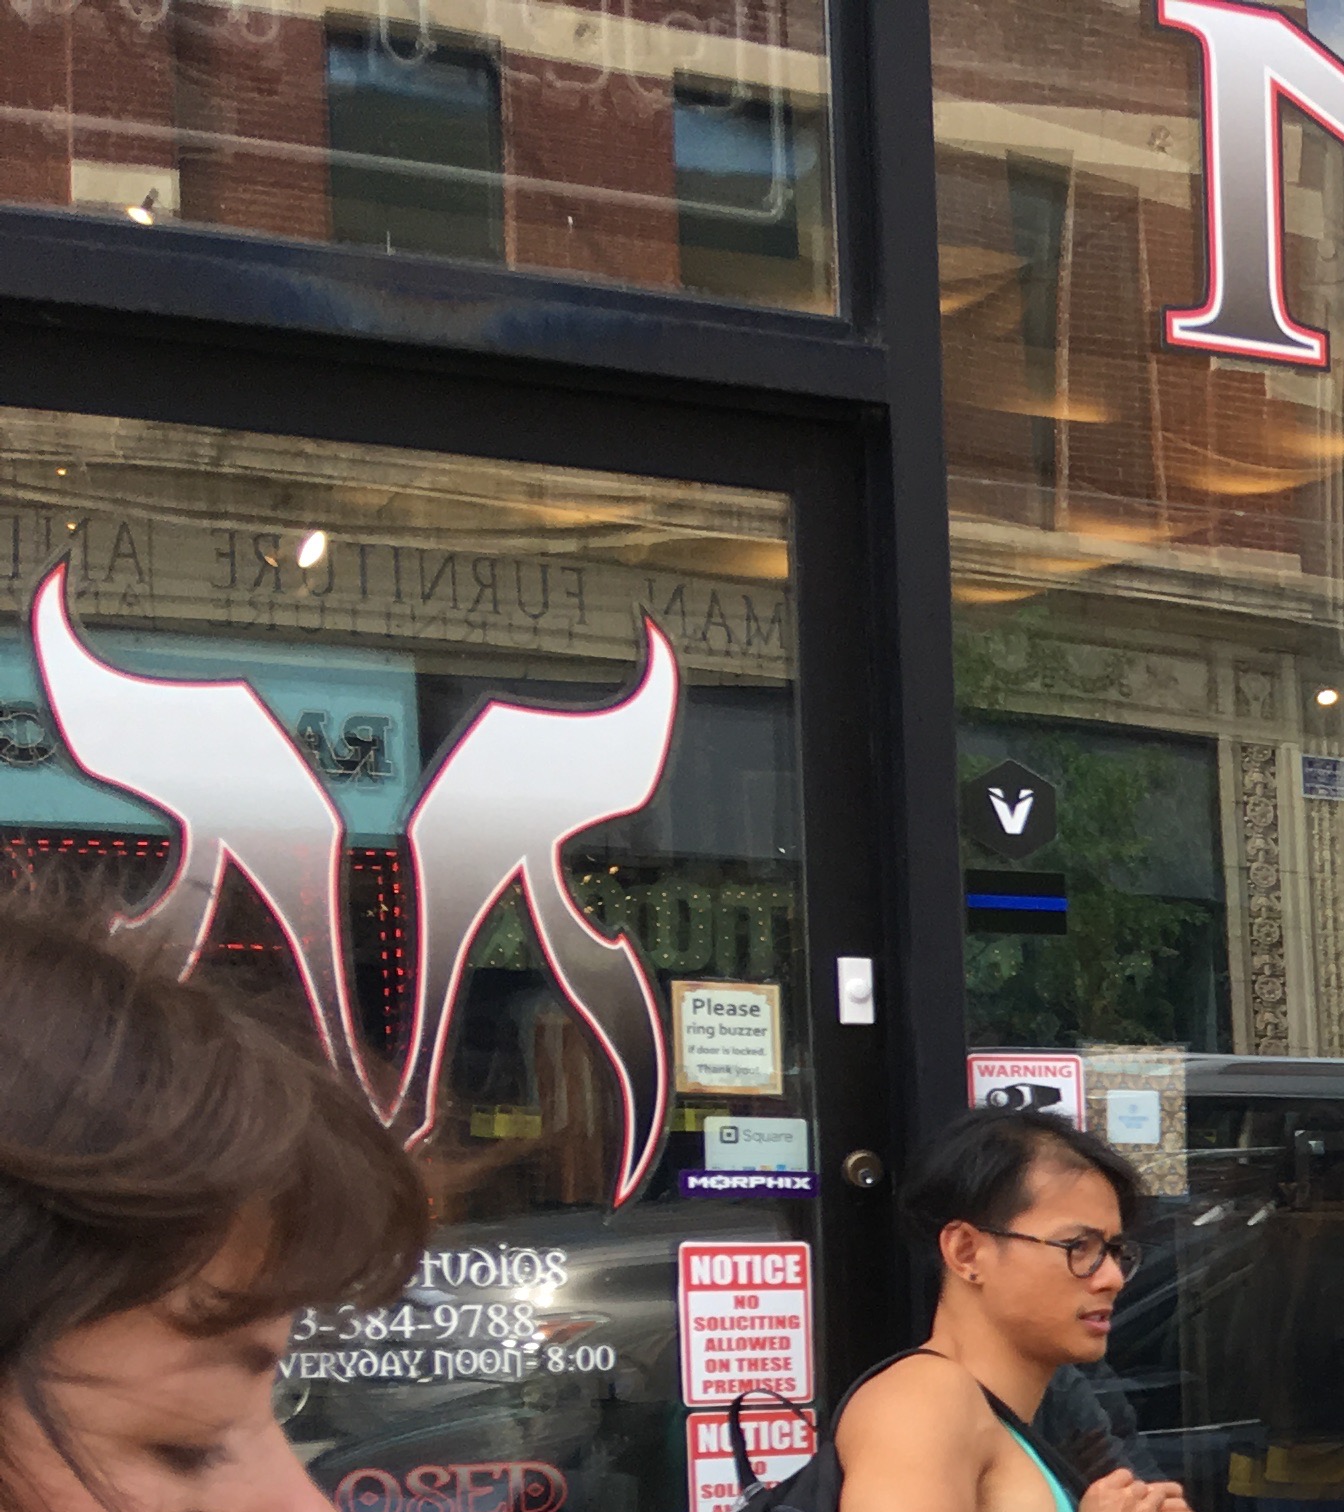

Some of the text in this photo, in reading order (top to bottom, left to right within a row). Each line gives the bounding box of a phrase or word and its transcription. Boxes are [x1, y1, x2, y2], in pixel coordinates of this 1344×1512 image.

[692, 998, 761, 1018] Please
[686, 1022, 767, 1039] ring buzzer
[977, 1064, 1073, 1078] WARNING
[742, 1129, 794, 1144] Square
[416, 1243, 569, 1291] tudios
[689, 1254, 803, 1286] NOTICE
[732, 1295, 760, 1310] NO
[693, 1315, 801, 1332] SOLICITING
[704, 1336, 792, 1352] ALLOWED
[547, 1345, 616, 1372] 8:00
[704, 1356, 792, 1374] ON THESE
[702, 1377, 797, 1395] PREMISES
